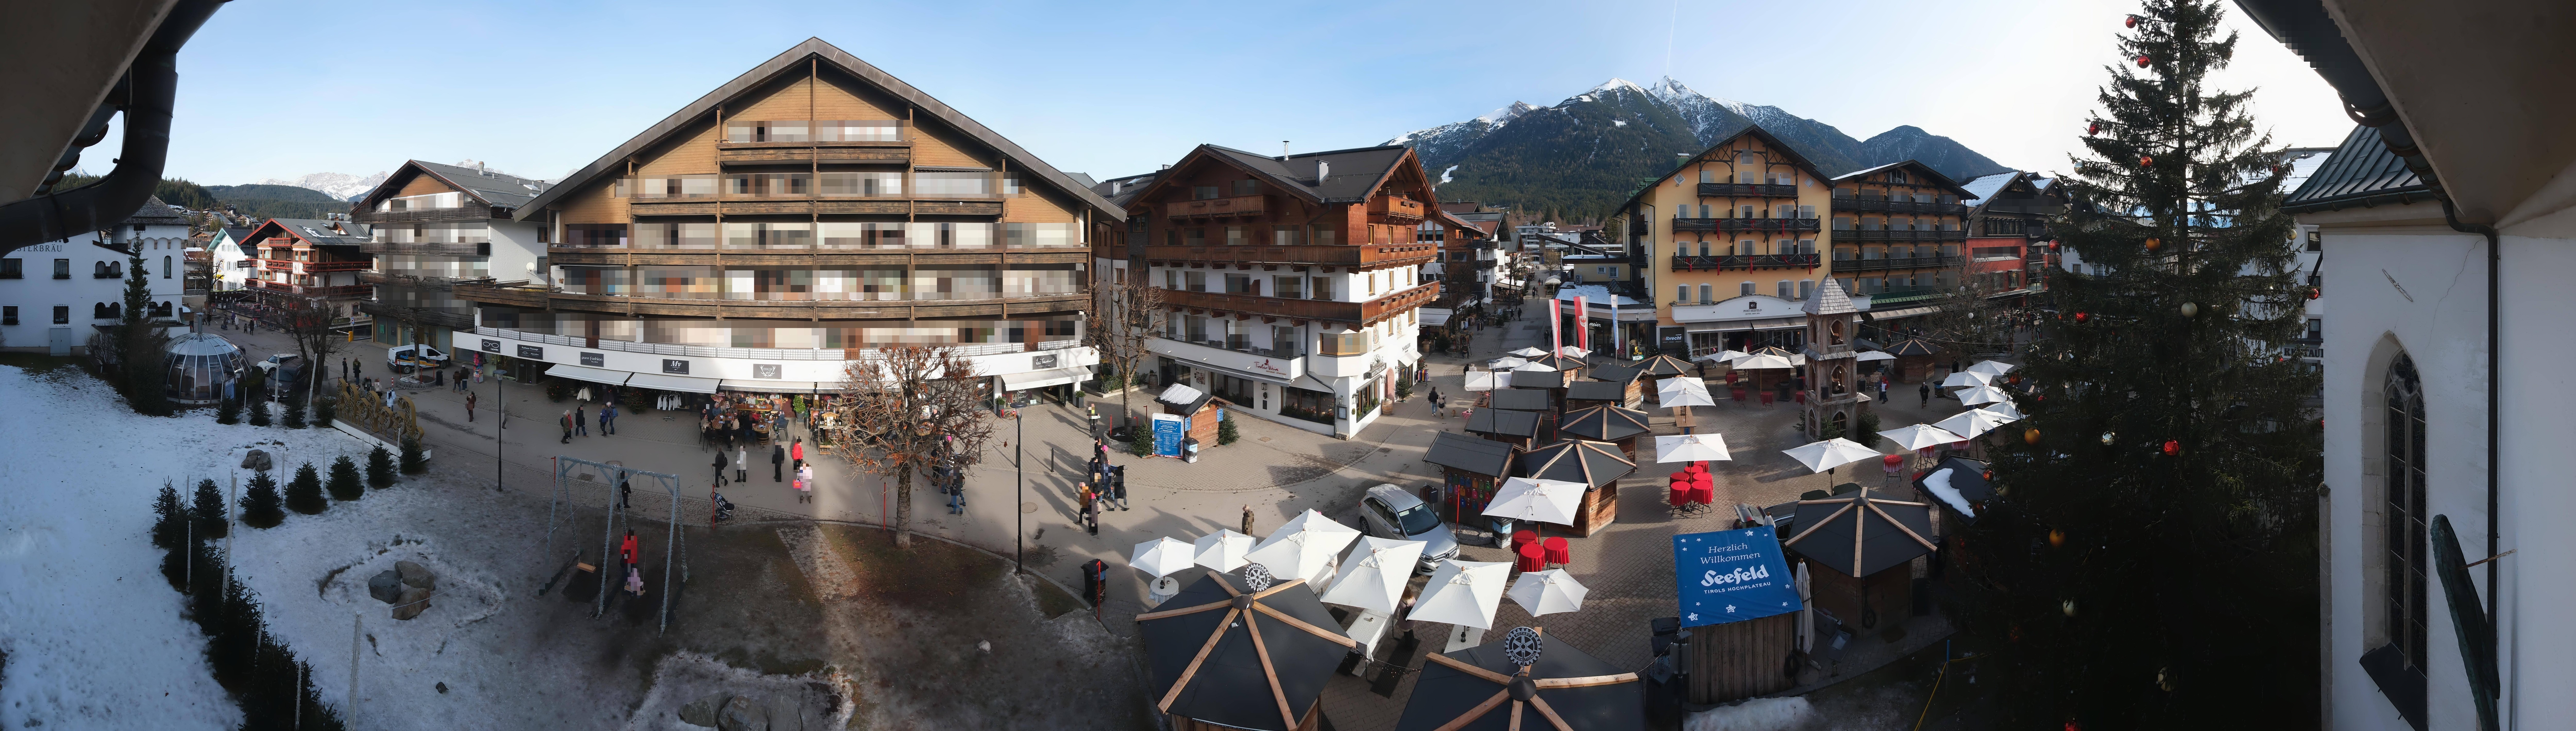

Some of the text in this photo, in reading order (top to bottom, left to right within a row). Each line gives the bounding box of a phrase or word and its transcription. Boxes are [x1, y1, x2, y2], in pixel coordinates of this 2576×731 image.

[1402, 343, 1411, 351] SAILER
[1371, 364, 1386, 377] RESTAURANT
[1708, 543, 1748, 553] Herzlich
[1700, 552, 1760, 564] Willkommen
[1701, 564, 1769, 586] Seefeld
[1248, 578, 1265, 589] INTERNAIONAL
[1728, 582, 1771, 591] HOCHPLATEAU
